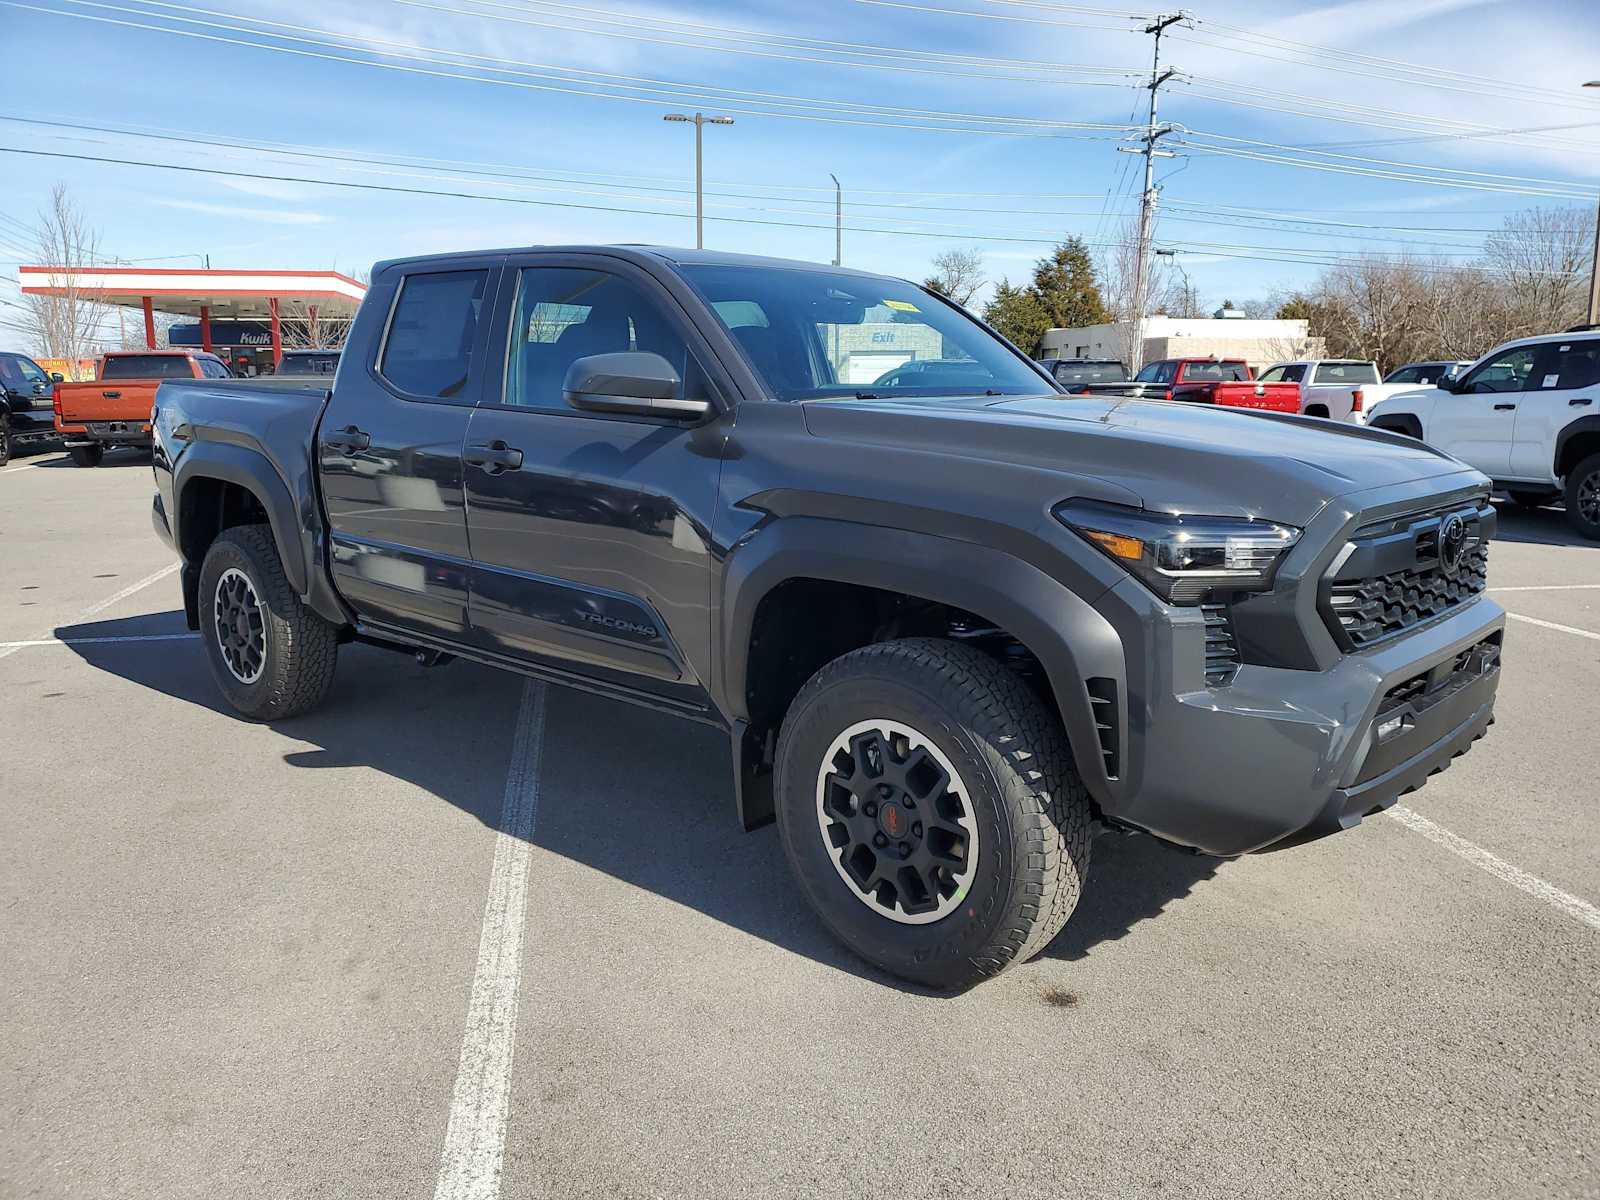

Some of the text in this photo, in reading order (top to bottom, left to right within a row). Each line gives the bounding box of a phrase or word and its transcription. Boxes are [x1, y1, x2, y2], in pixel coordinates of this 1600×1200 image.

[239, 332, 272, 345] Kwik
[871, 331, 896, 343] Exit
[580, 612, 658, 638] TACOMA
